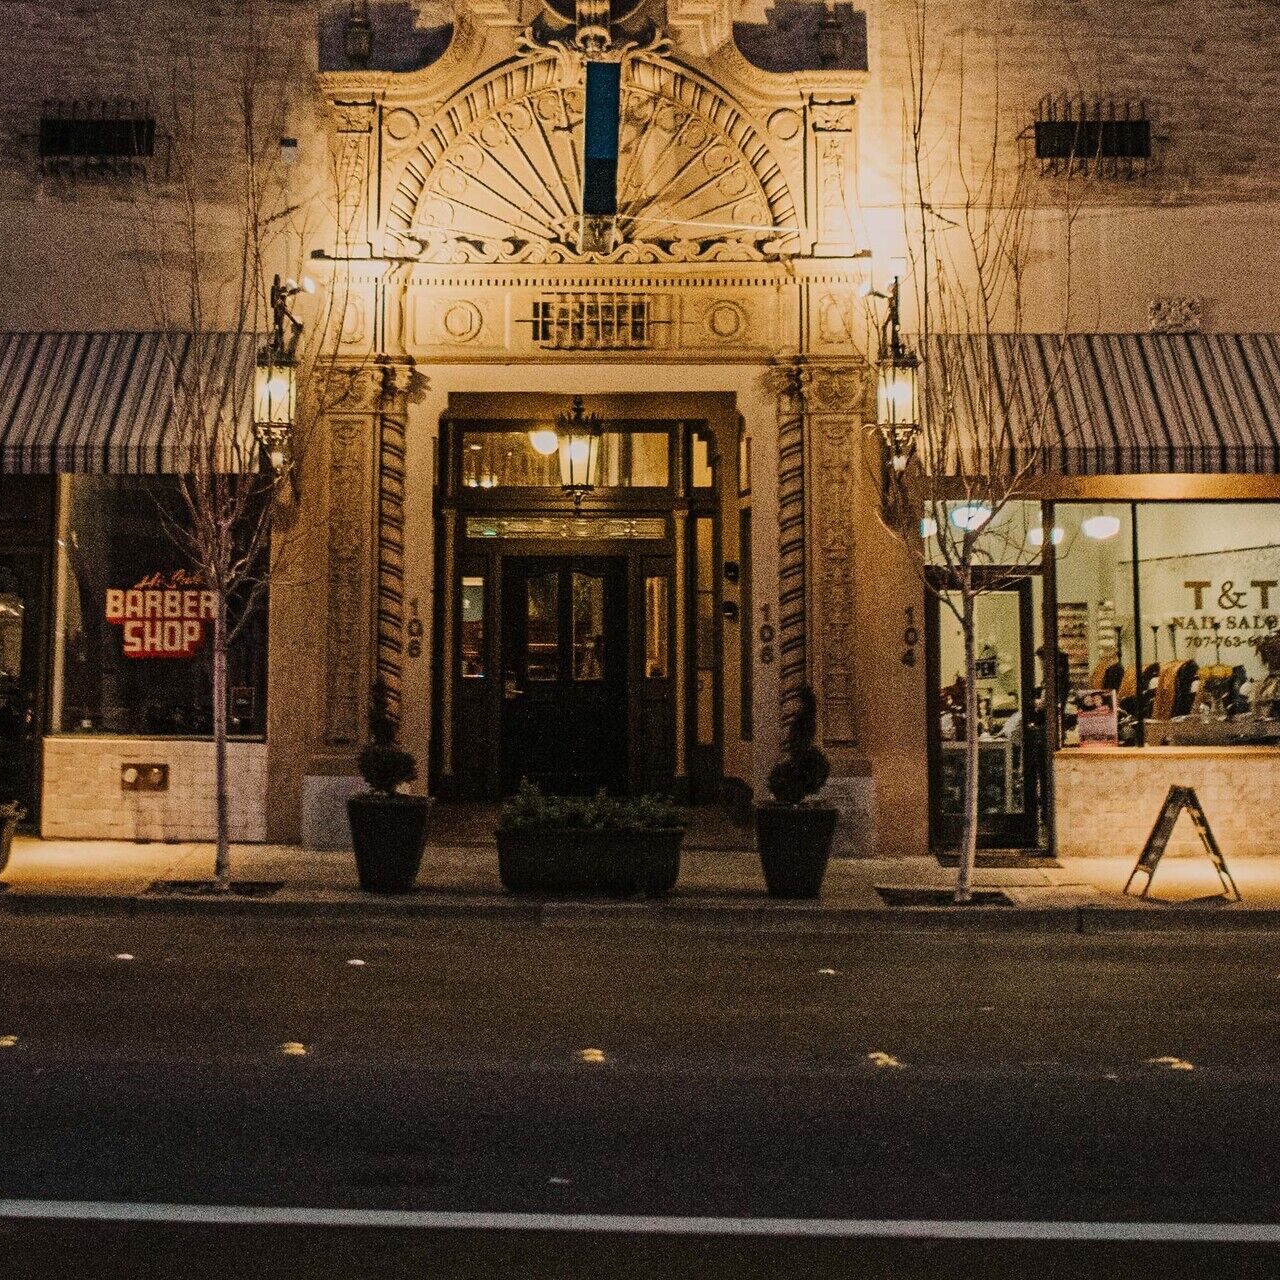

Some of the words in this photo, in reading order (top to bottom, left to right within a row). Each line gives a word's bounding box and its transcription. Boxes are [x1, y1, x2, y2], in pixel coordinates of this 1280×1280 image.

[106, 588, 219, 619] BARBER
[124, 620, 201, 651] SHOP
[1172, 616, 1217, 630] NAIL
